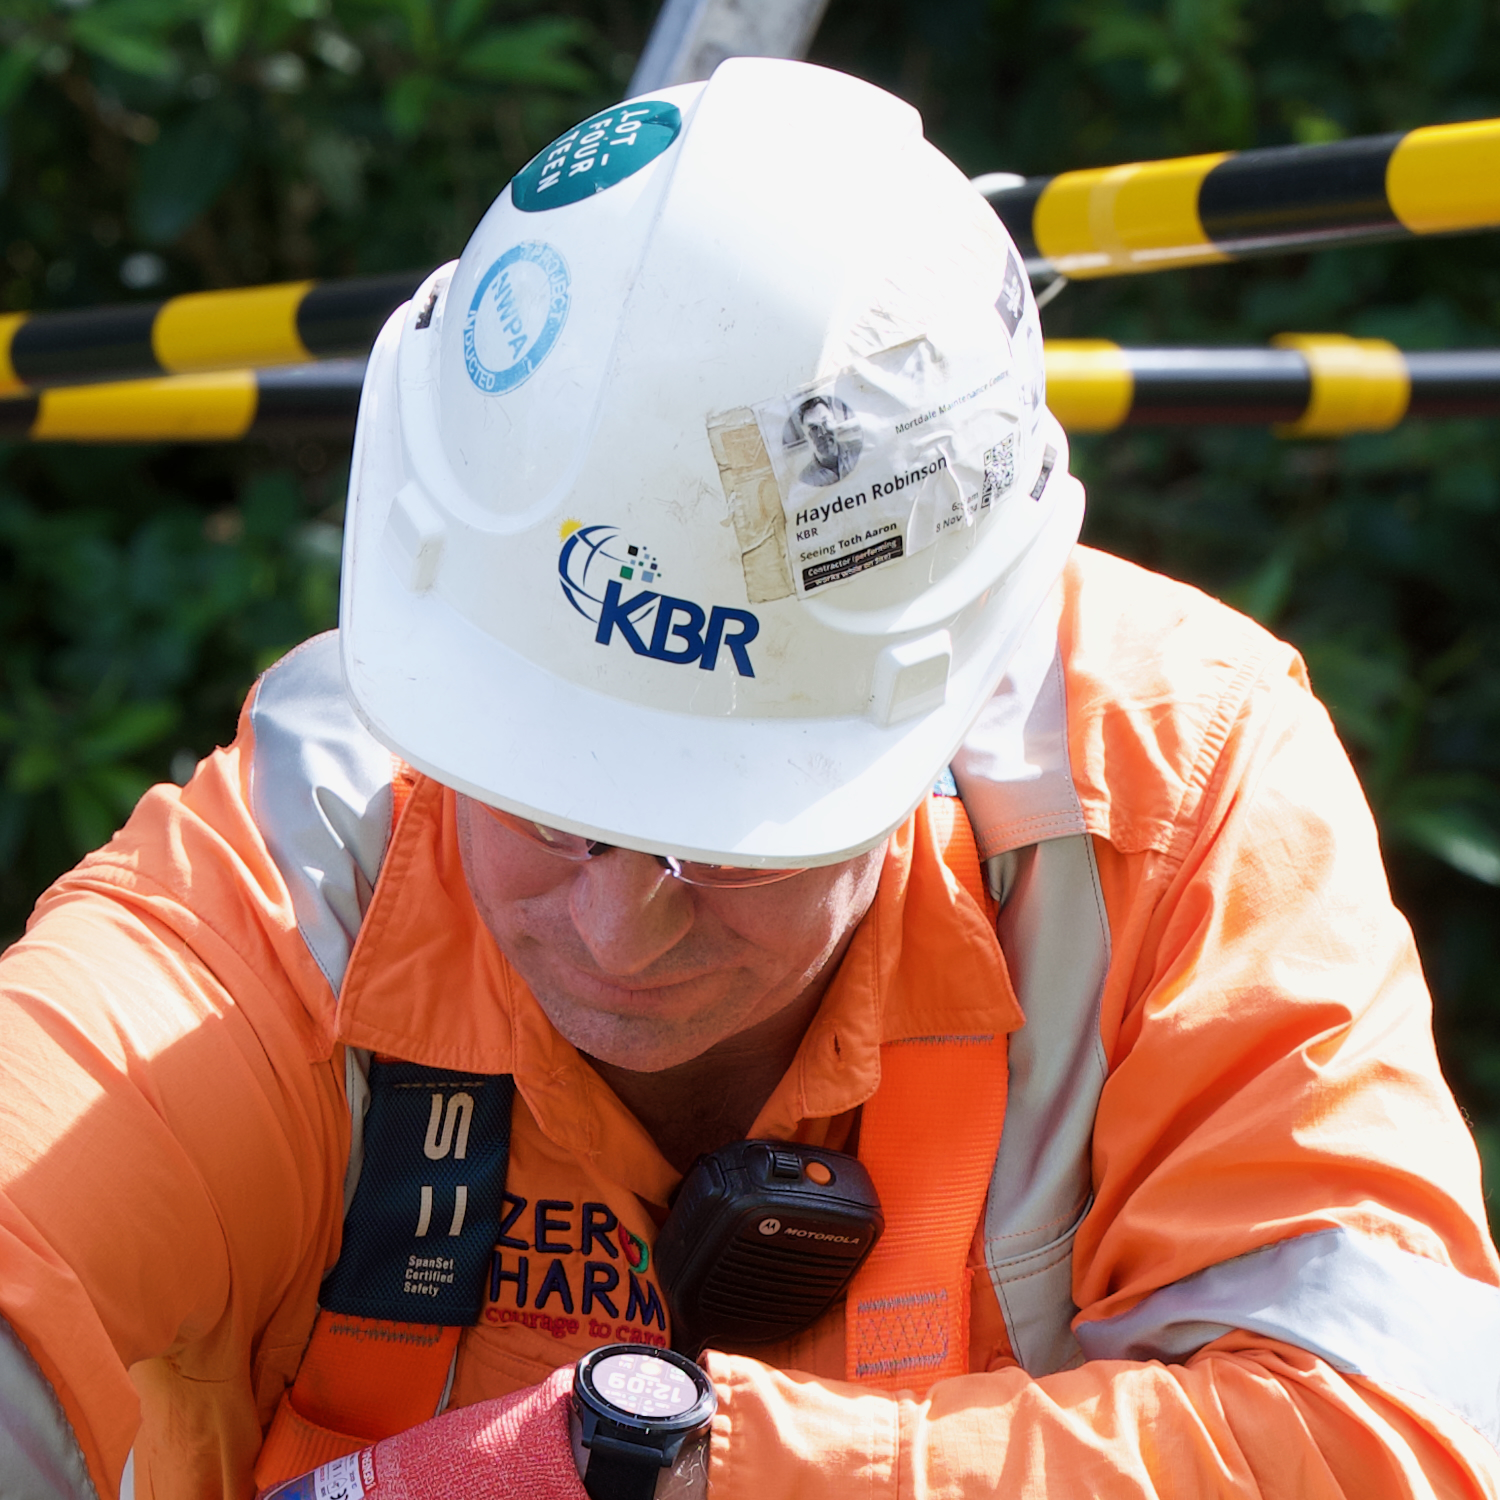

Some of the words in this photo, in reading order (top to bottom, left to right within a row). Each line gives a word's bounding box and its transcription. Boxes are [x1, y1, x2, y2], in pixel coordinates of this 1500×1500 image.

[568, 117, 613, 178] FOUR
[610, 108, 650, 146] LOT
[536, 129, 580, 194] TEEN
[491, 271, 528, 360] NWPA
[464, 310, 496, 391] INDUCTED
[895, 410, 938, 435] Mortdale
[938, 384, 988, 415] Maintenance
[795, 491, 868, 526] Hayden
[871, 456, 948, 501] Robinson
[796, 526, 819, 543] KBR
[799, 544, 837, 563] Seeing
[837, 533, 863, 550] Toth
[864, 521, 898, 540] Aaron
[942, 514, 963, 530] Nov
[807, 557, 851, 577] Contractor
[595, 579, 760, 678] KBR
[783, 1227, 860, 1245] MOTOROLA
[405, 1269, 455, 1284] Certified
[408, 1255, 454, 1270] SpanSet
[403, 1282, 440, 1297] Safety
[489, 1251, 666, 1331] HARM
[485, 1306, 580, 1339] courage
[589, 1318, 611, 1339] to
[615, 1324, 667, 1348] care
[607, 1372, 682, 1404] 12:09
